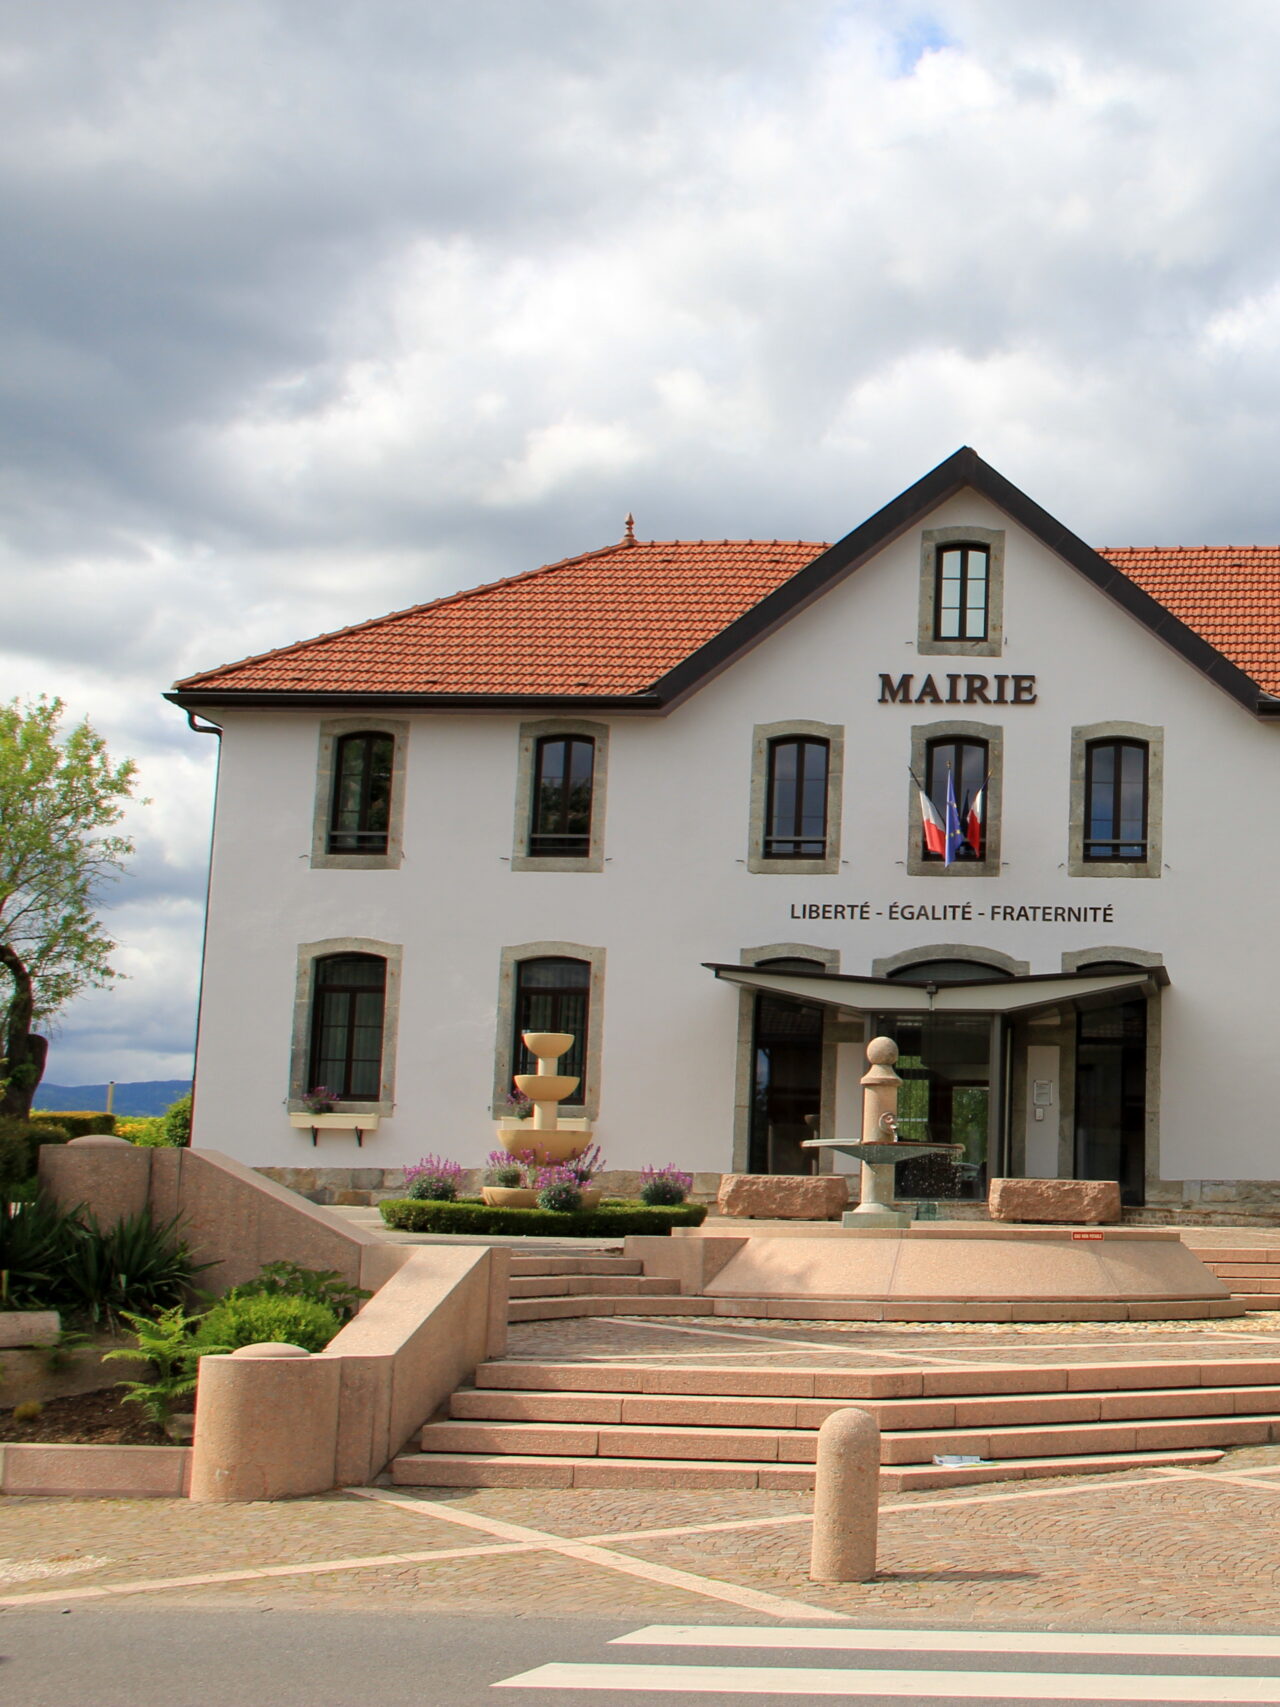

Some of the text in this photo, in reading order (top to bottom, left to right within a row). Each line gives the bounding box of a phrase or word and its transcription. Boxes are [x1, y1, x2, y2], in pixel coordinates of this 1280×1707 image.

[877, 673, 1037, 705] MAIRIE
[790, 901, 871, 920] LIBERTÉ
[888, 901, 973, 921] ÉGALITÉ
[990, 903, 1114, 923] FRATERNITÉ
